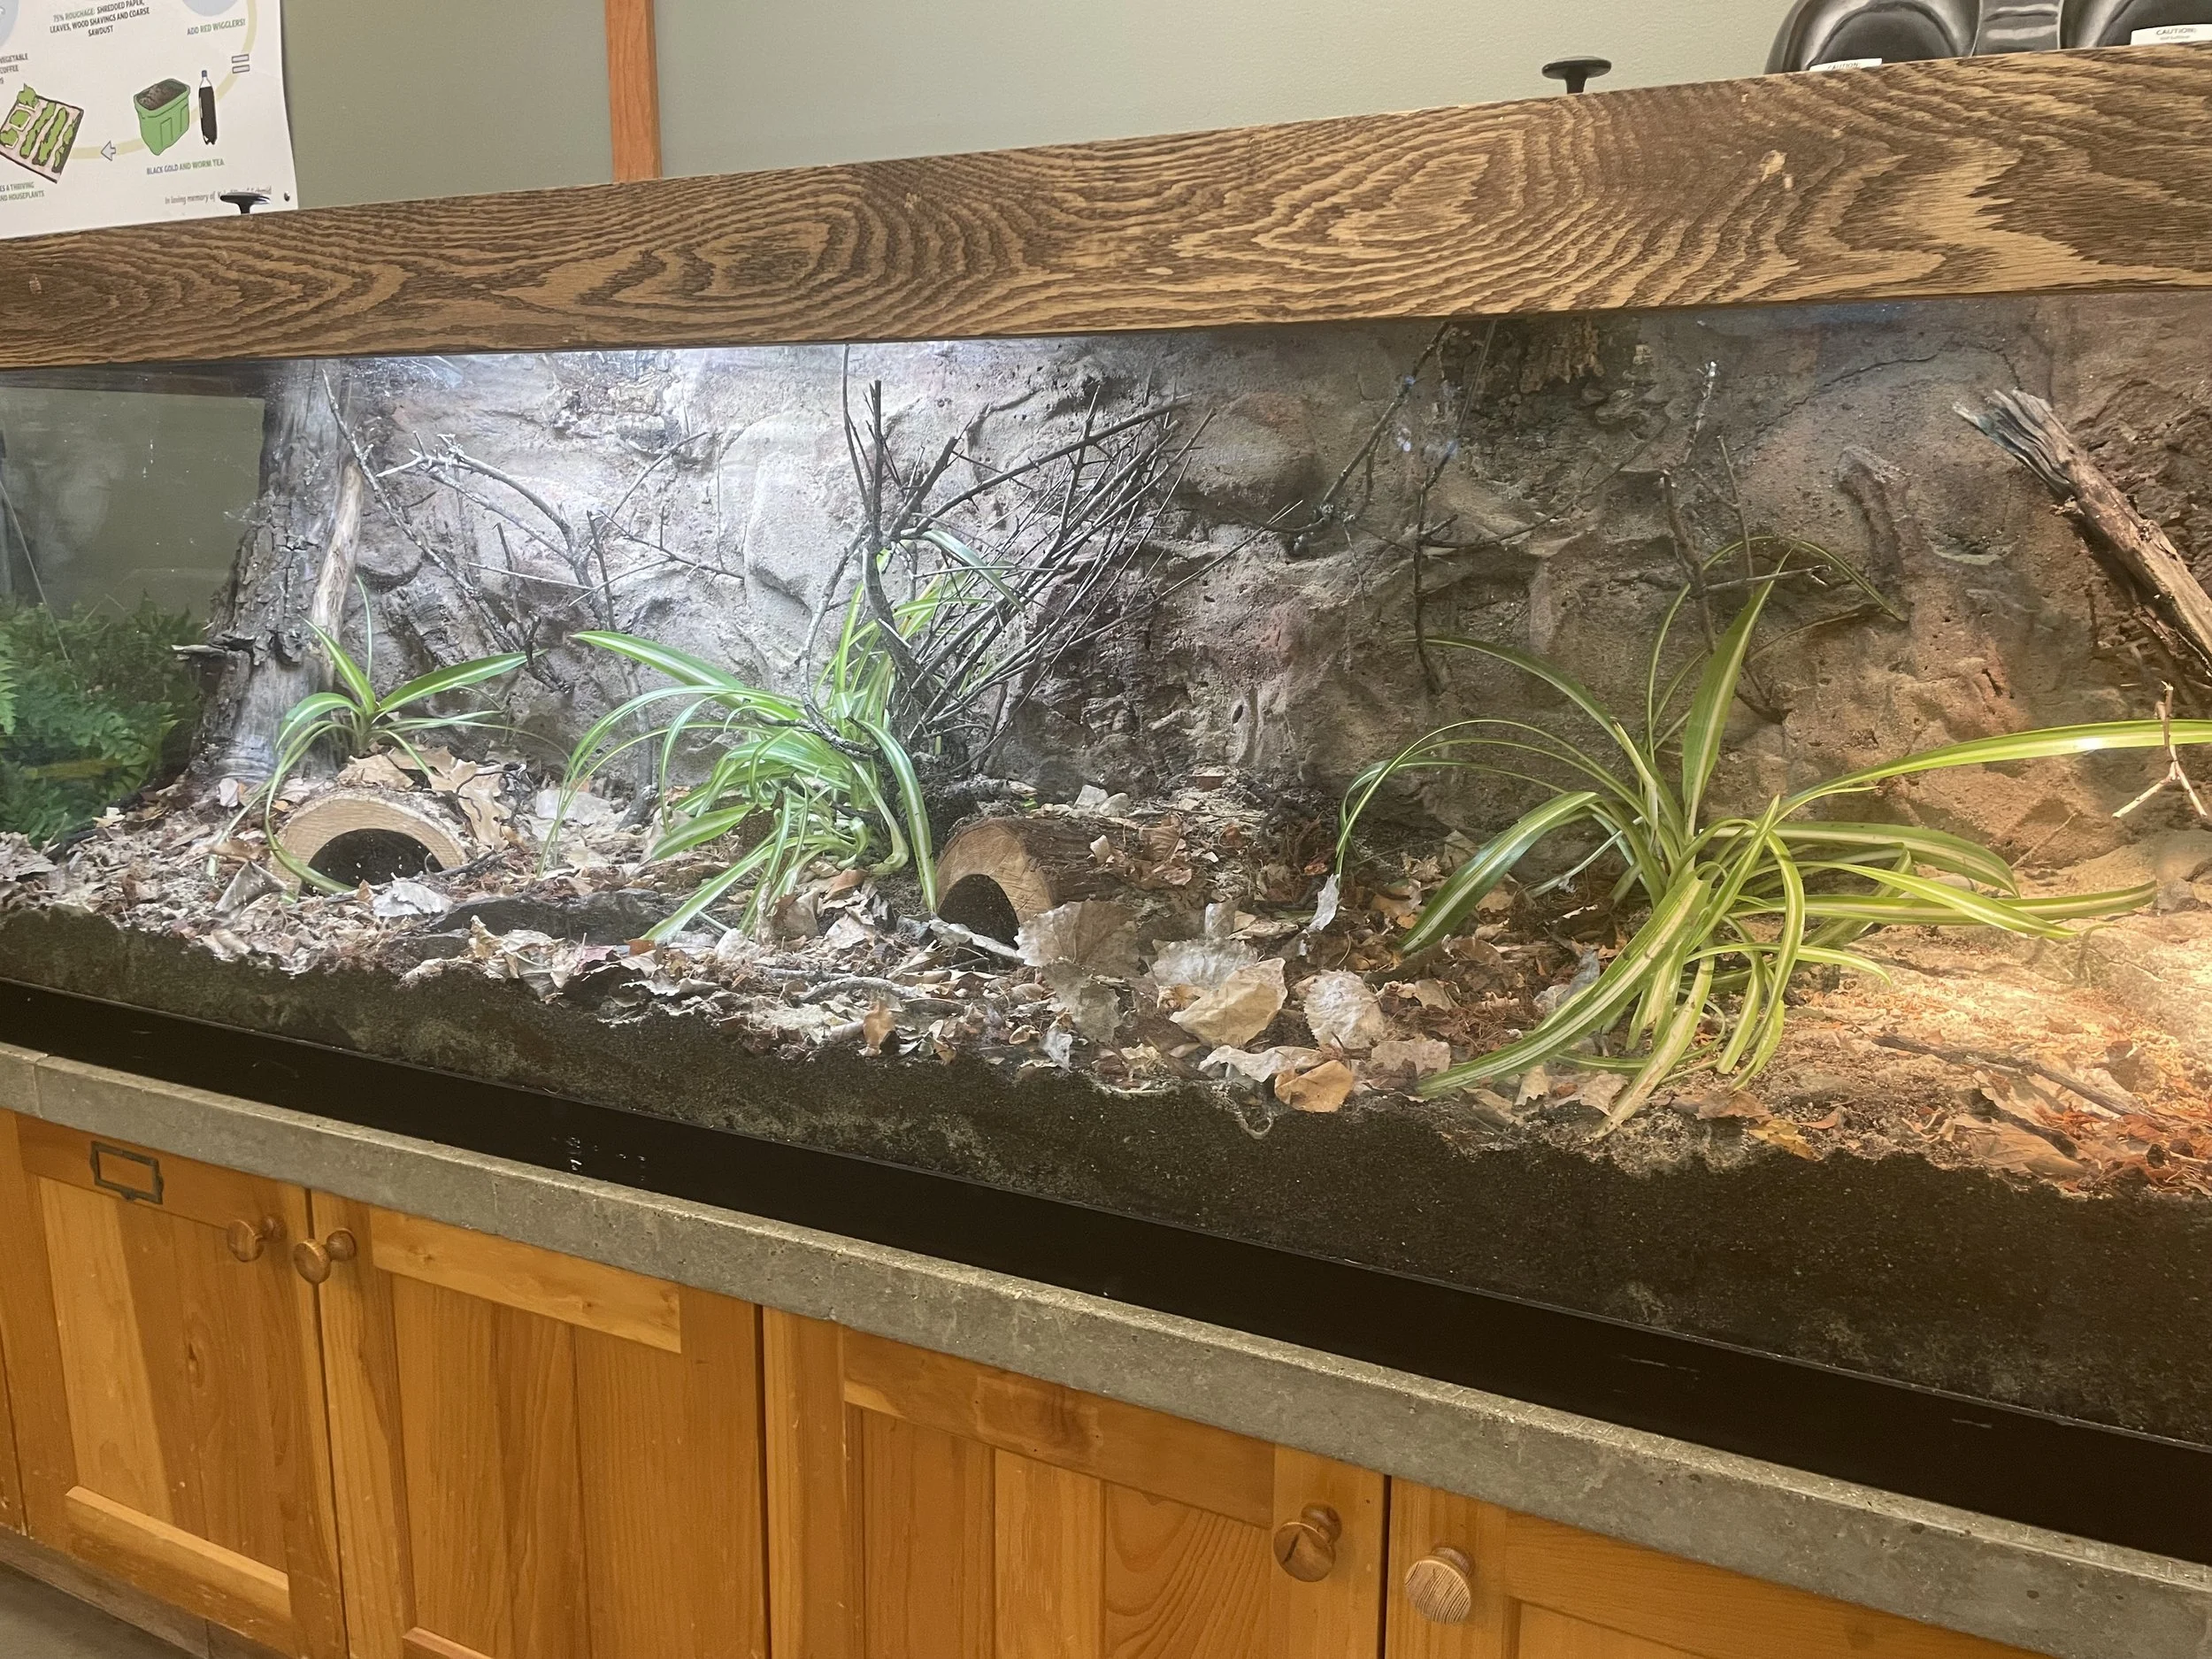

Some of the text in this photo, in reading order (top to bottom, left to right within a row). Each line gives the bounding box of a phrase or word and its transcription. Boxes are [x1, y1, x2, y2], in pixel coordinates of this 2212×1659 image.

[96, 2, 125, 14] SHREDDED
[50, 7, 150, 34] LEAVES, WOOD SHAVINGS AND COARSE
[88, 25, 114, 36] SAWDUST
[187, 27, 199, 35] ADD
[200, 24, 212, 34] RED
[146, 165, 163, 175] BLACK
[164, 164, 179, 173] GOLD
[192, 159, 211, 169] WORM
[212, 158, 225, 167] TEA
[188, 194, 208, 204] memory
[210, 191, 216, 203] of
